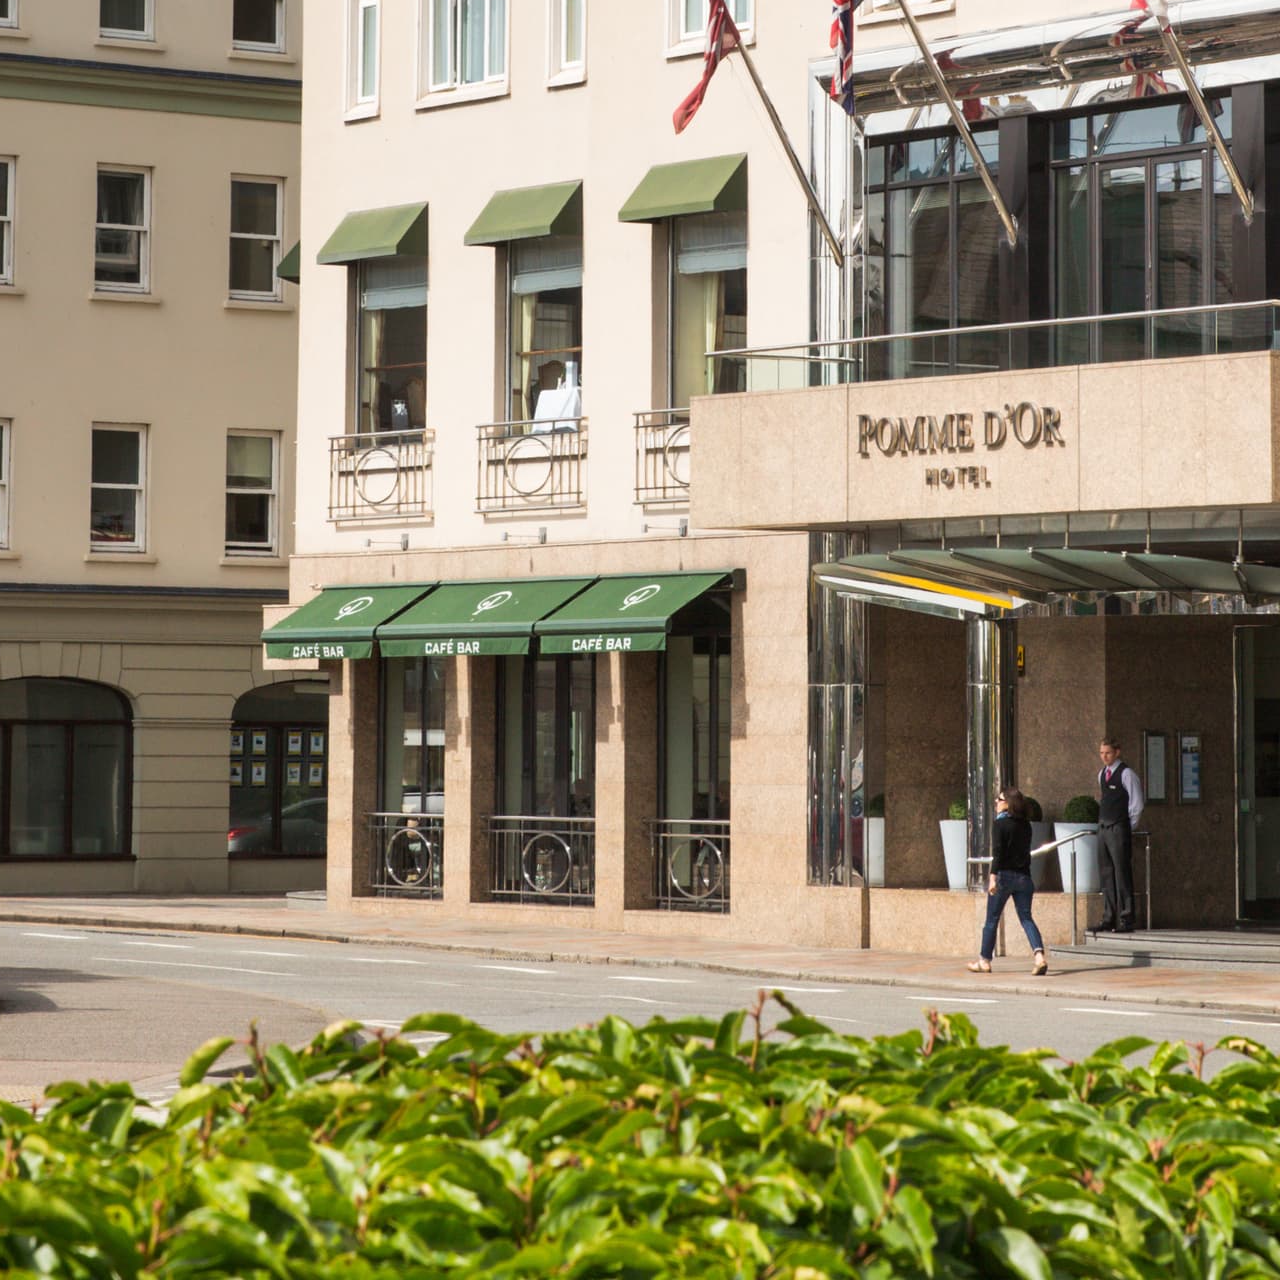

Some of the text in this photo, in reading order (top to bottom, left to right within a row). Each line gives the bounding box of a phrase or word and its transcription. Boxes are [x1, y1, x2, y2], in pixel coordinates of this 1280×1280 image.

[857, 402, 1066, 458] POMME D'OR
[925, 466, 991, 488] HOTEL
[292, 642, 344, 658] CAFÉ BAR
[425, 638, 480, 654] CAFÉ BAR
[572, 635, 632, 651] CAFÉ BAR
